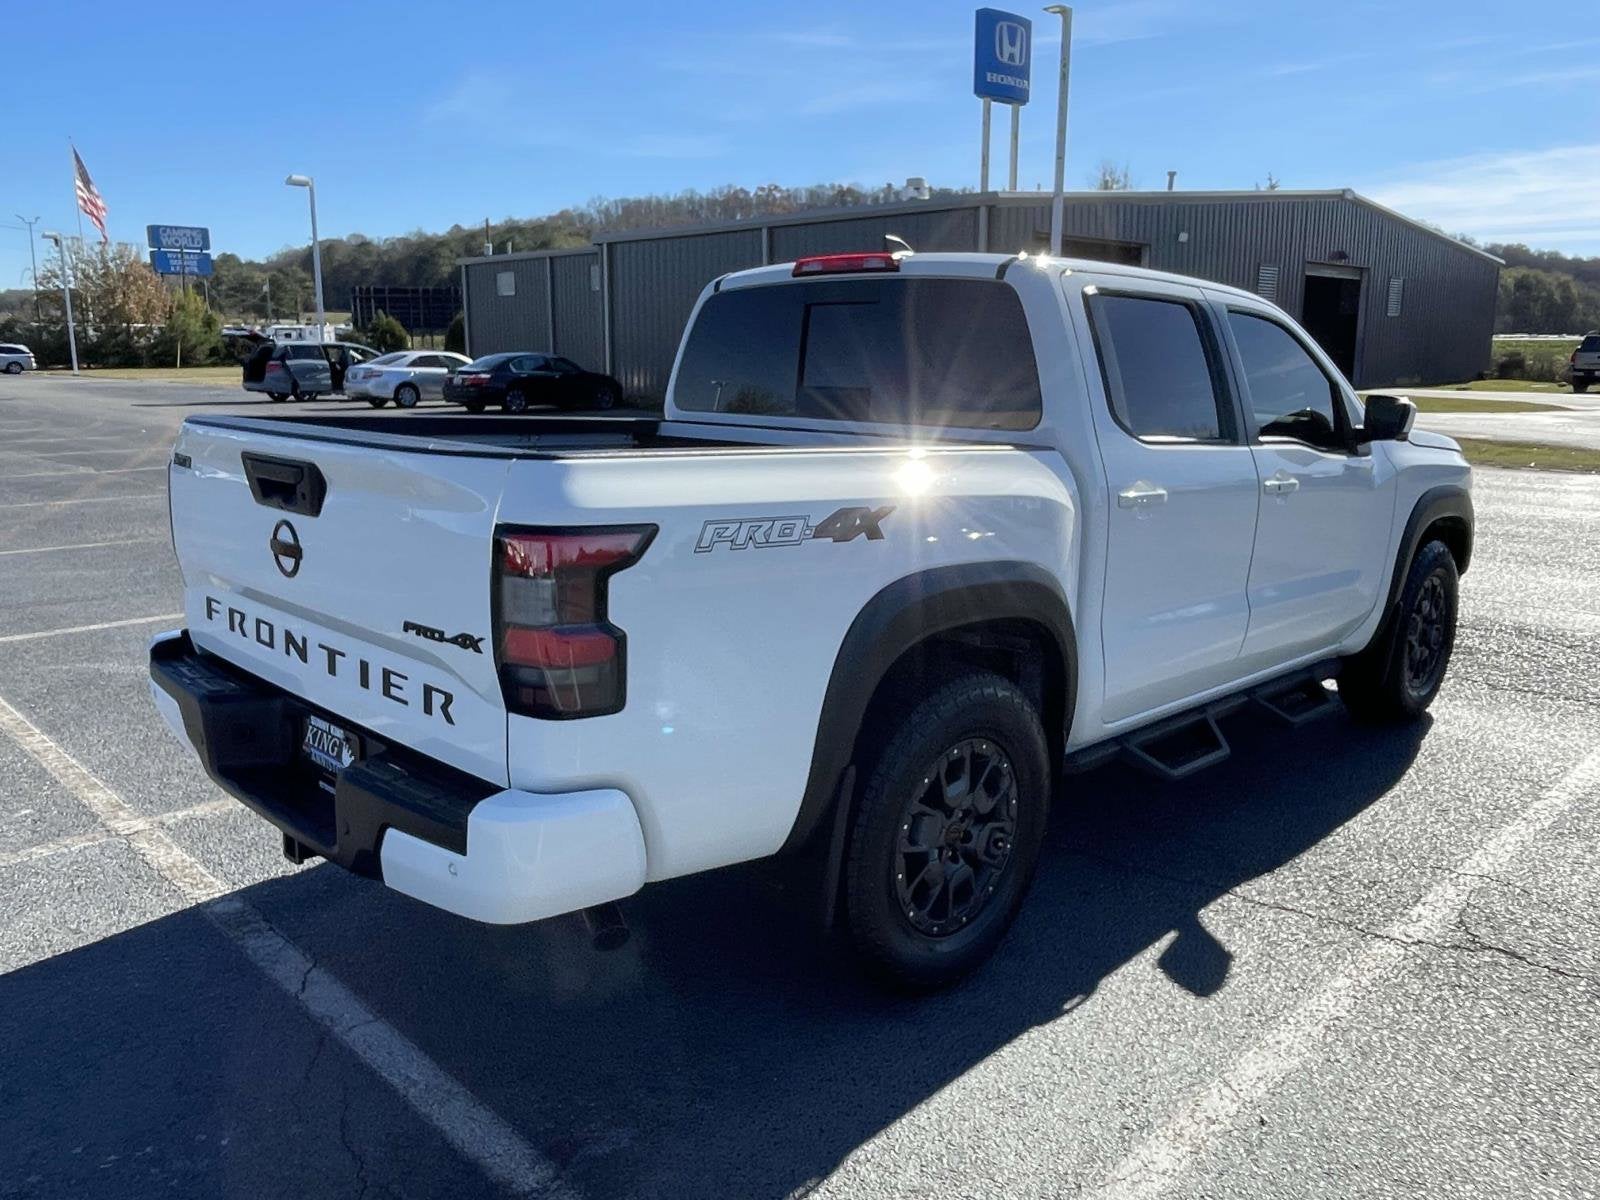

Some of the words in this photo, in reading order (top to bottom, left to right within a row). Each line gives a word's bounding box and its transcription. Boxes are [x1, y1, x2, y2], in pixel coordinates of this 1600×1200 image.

[986, 72, 1029, 89] HONDA
[160, 227, 202, 238] CAMPING
[161, 235, 203, 247] WORLD
[206, 596, 455, 726] FRONTIER
[306, 725, 340, 757] KING
